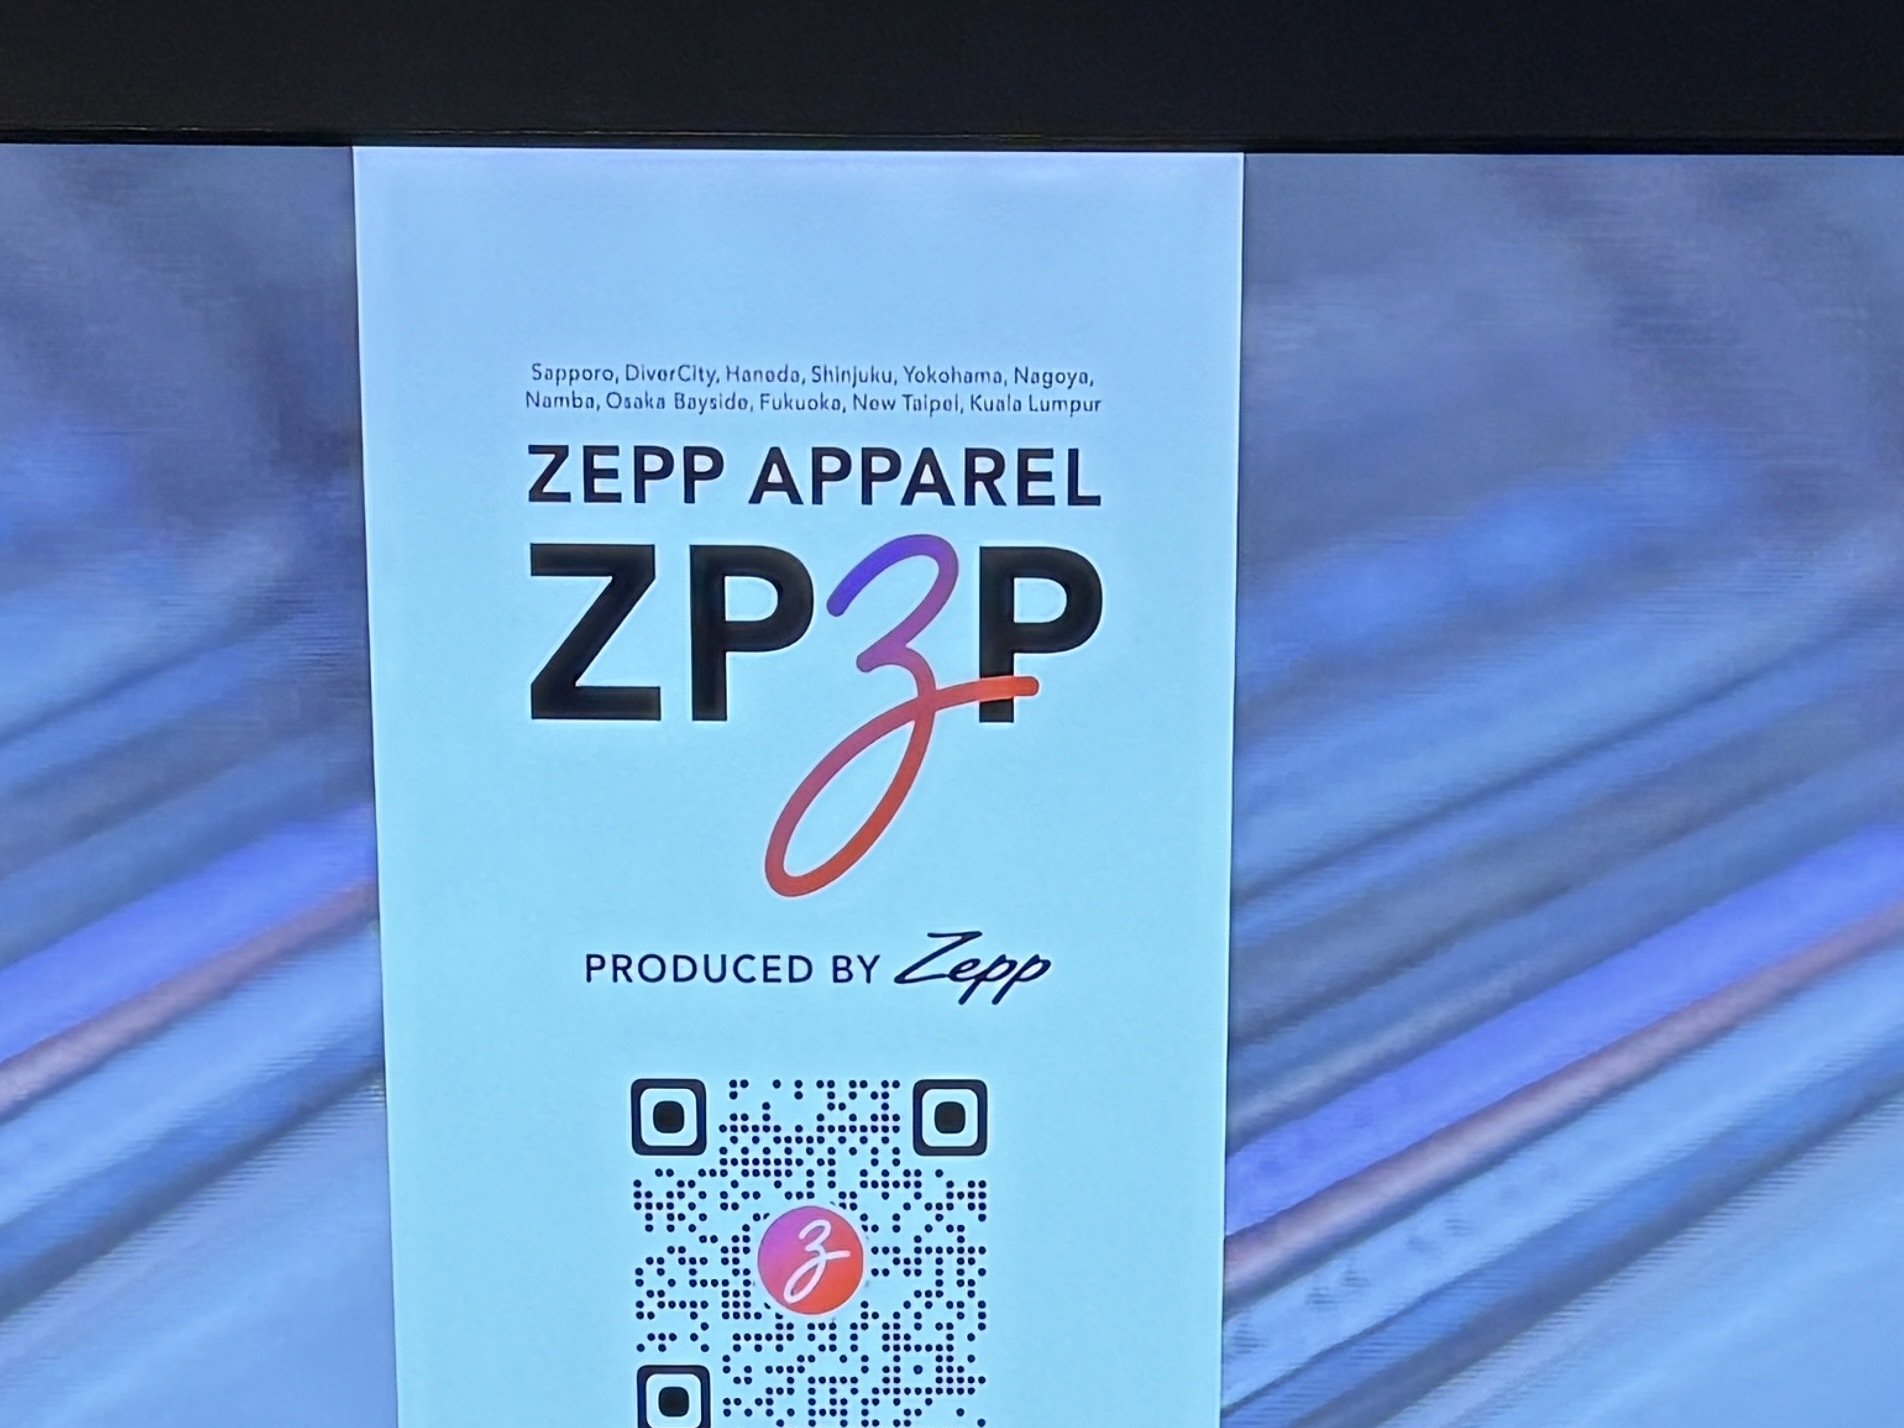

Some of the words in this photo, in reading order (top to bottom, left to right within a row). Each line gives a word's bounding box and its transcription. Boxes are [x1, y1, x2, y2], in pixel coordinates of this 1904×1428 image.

[531, 362, 619, 387] Sapporo,
[811, 364, 898, 389] Shinjuku,
[903, 365, 1008, 387] Yokohama,
[1014, 366, 1094, 391] Nagoya,
[525, 389, 601, 412] Namba,
[605, 391, 666, 410] Osaka
[759, 392, 847, 414] Fukuoka,
[853, 393, 897, 411] New
[970, 394, 1022, 413] Kuala
[1028, 393, 1102, 418] Lumpur
[527, 444, 724, 504] ZEPP
[748, 446, 1102, 507] APPAREL
[585, 953, 813, 984] PRODUCED
[832, 954, 881, 984] BY
[893, 930, 1052, 1006] Zepp
